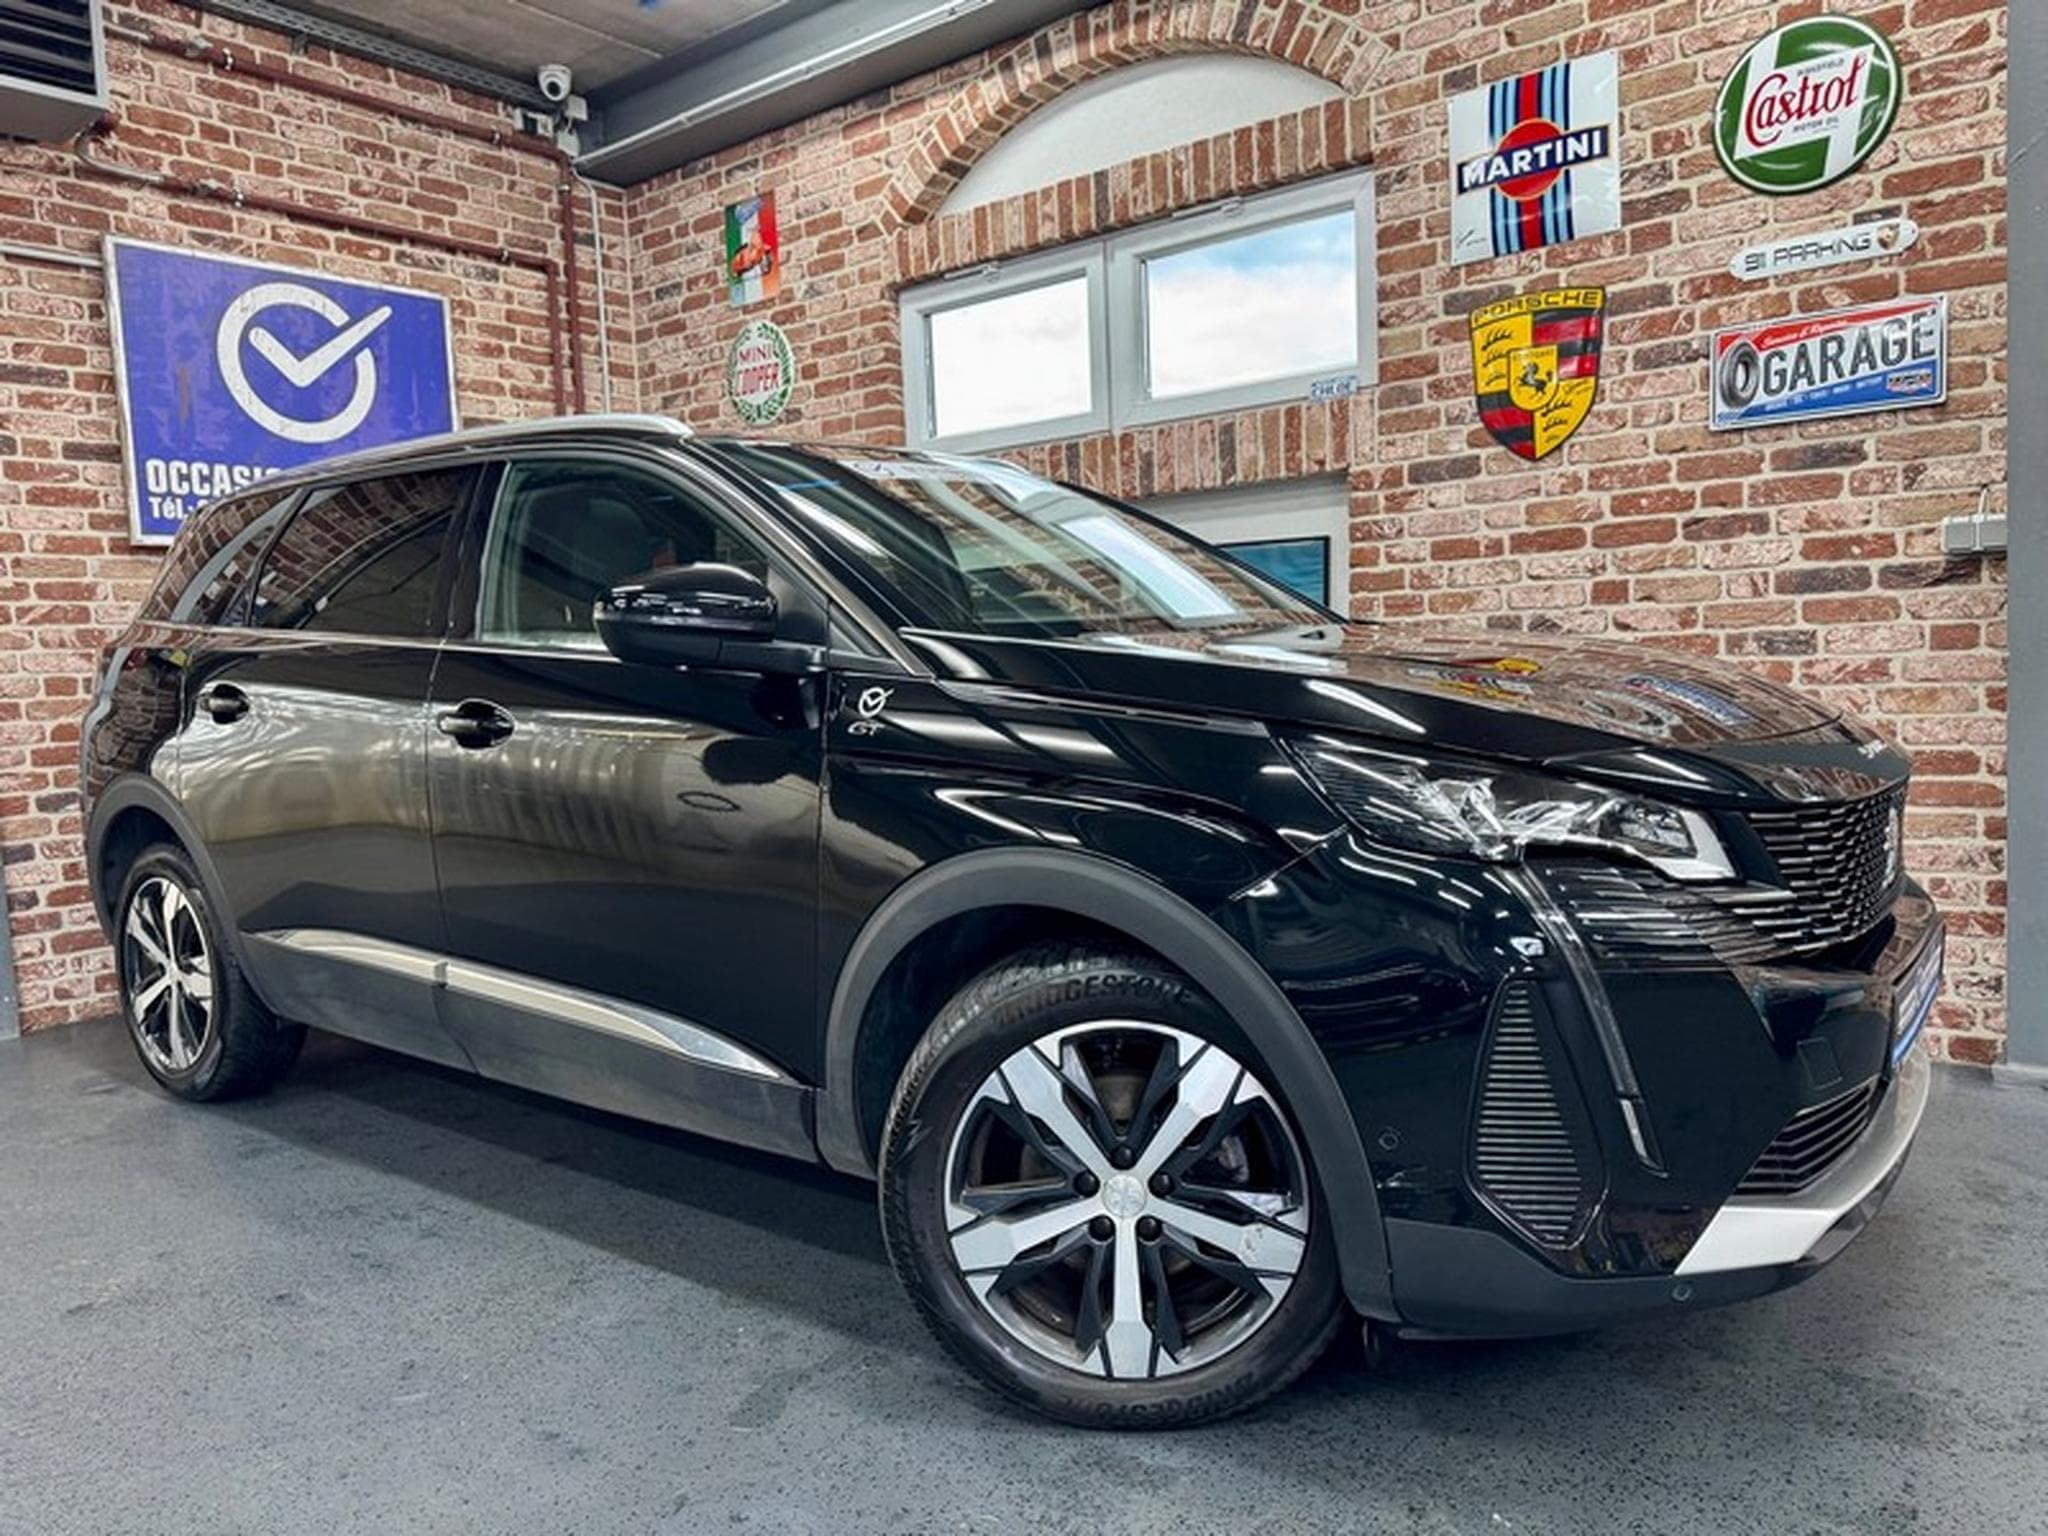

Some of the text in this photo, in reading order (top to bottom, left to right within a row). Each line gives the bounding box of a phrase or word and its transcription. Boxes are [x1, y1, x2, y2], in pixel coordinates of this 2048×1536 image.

[1746, 52, 1867, 148] Castrol
[1461, 129, 1601, 189] MARTINI
[1774, 232, 1872, 266] PARKING
[1474, 291, 1599, 323] PORSCHE
[739, 343, 772, 363] MINI
[1763, 308, 1937, 397] GARAGE
[145, 458, 282, 497] OCCAS
